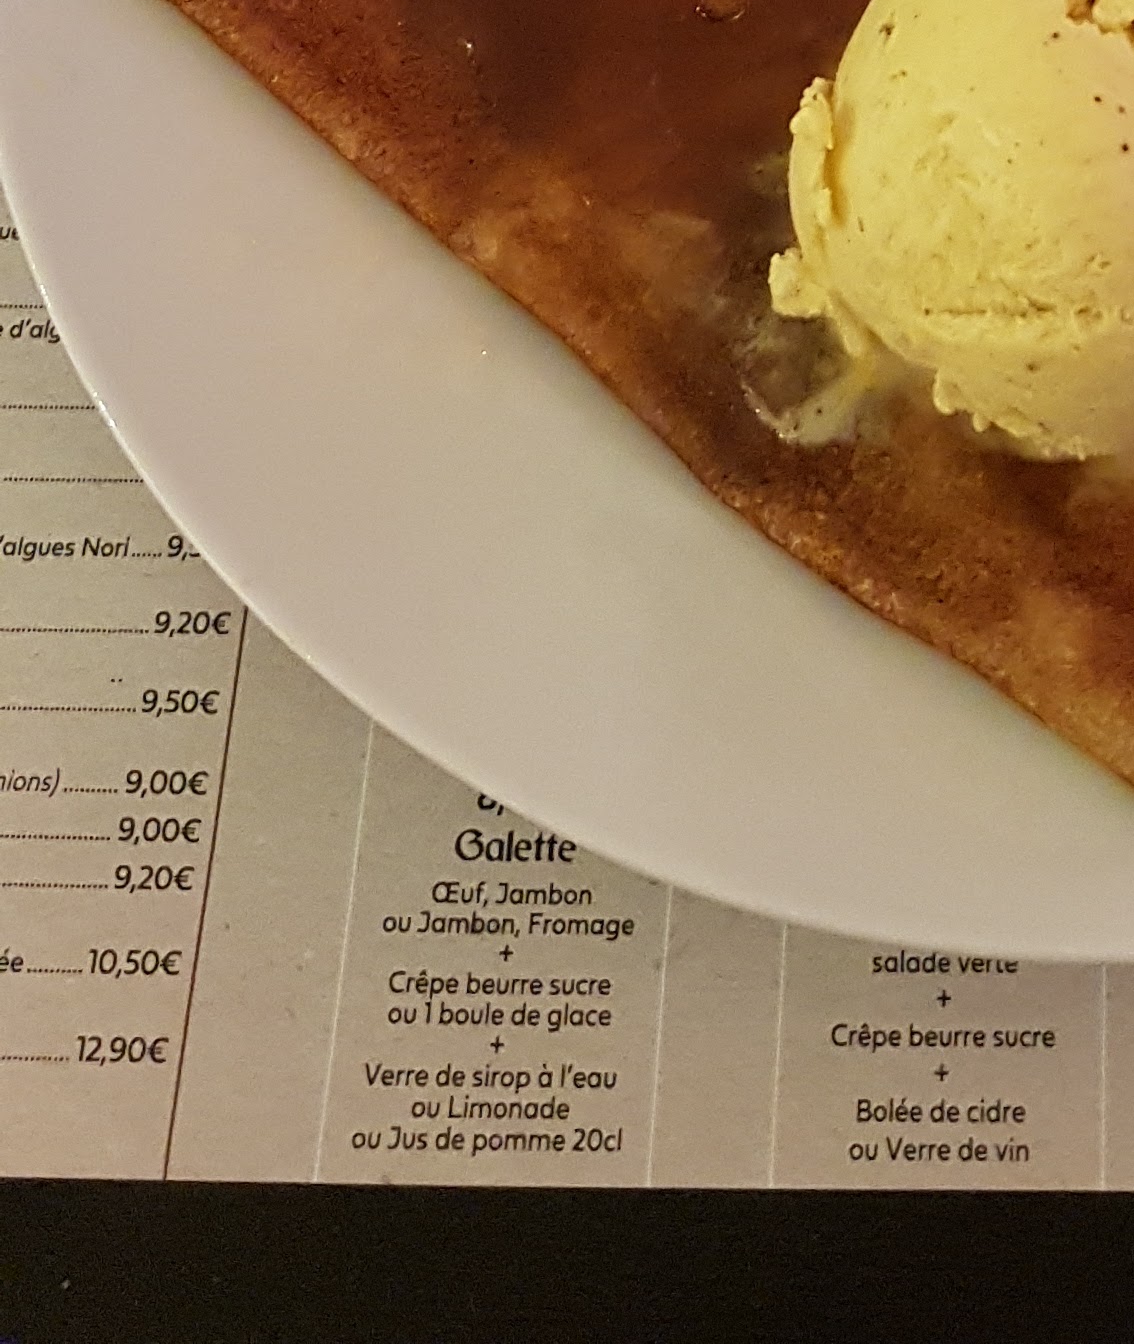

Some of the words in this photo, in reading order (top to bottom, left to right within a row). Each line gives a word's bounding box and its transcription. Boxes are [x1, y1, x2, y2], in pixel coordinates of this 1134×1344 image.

[153, 610, 232, 638] 9,20€
[141, 688, 221, 718] 9,50€
[125, 769, 210, 799] 9,00€
[117, 816, 203, 846] 9,00€
[454, 828, 578, 863] Galette
[114, 864, 196, 894] 9,20€
[431, 880, 489, 908] Œuf,
[494, 882, 593, 906] Jambon
[382, 915, 412, 934] ou
[416, 910, 521, 939] Jambon,
[528, 912, 635, 942] Fromage
[88, 948, 183, 980] 10,50€
[388, 968, 460, 1001] Crêpe
[465, 971, 544, 996] beurre
[548, 978, 612, 996] sucre
[387, 1006, 418, 1025] ou
[424, 1000, 433, 1025] 1
[437, 1000, 505, 1027] boule
[510, 1001, 541, 1027] de
[547, 1002, 612, 1034] glace
[77, 1035, 170, 1067] 12,90€
[830, 1022, 902, 1054] Crêpe
[908, 1022, 987, 1049] beurre
[992, 1030, 1056, 1049] sucre
[364, 1062, 429, 1088] Verre
[435, 1062, 466, 1088] de
[471, 1063, 532, 1095] sirop
[537, 1063, 554, 1089] à
[410, 1100, 441, 1120] ou
[447, 1094, 570, 1121] Limonade
[856, 1097, 924, 1124] Bolée
[929, 1098, 961, 1124] de
[966, 1097, 1027, 1125] cidre
[351, 1131, 382, 1150] ou
[386, 1125, 429, 1151] Jus
[434, 1125, 466, 1152] de
[470, 1133, 566, 1158] pomme
[571, 1127, 623, 1153] 20cl
[848, 1142, 879, 1162] ou
[885, 1136, 952, 1162] Verre
[957, 1136, 988, 1163] de
[993, 1136, 1030, 1163] vin
